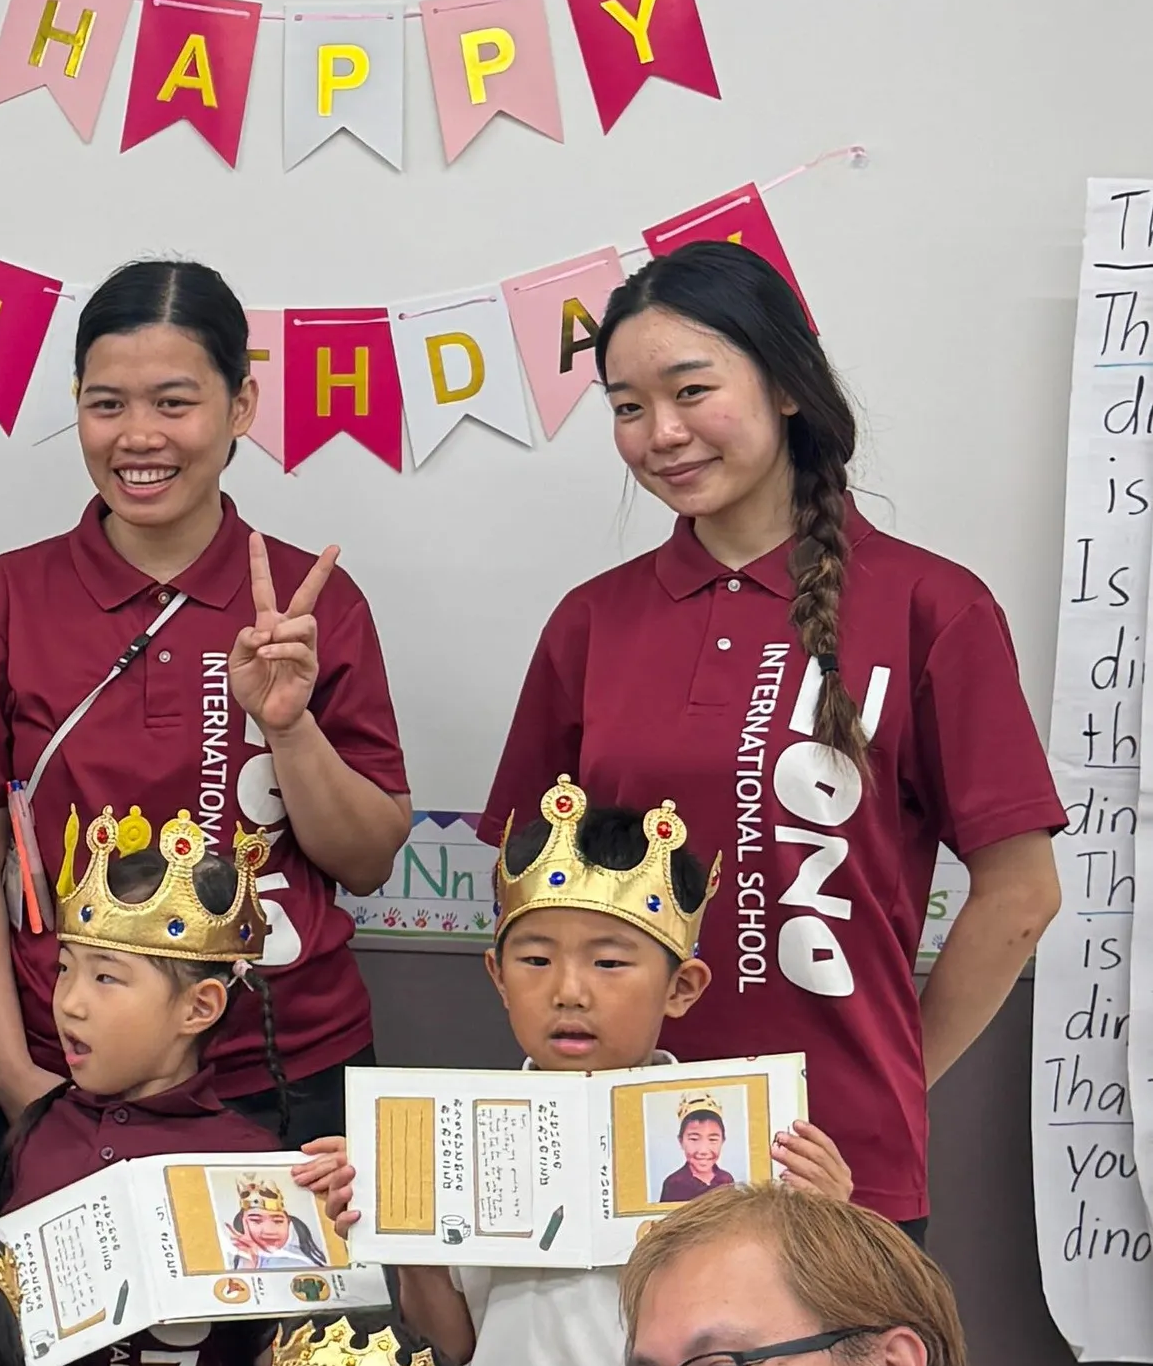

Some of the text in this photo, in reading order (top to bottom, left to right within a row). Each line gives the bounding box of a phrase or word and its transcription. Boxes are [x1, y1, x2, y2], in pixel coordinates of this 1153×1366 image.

[1107, 456, 1149, 516] is
[1070, 537, 1131, 607] Is
[736, 642, 791, 994] INTERNATIONAL SCHOOL
[1083, 918, 1123, 970] is
